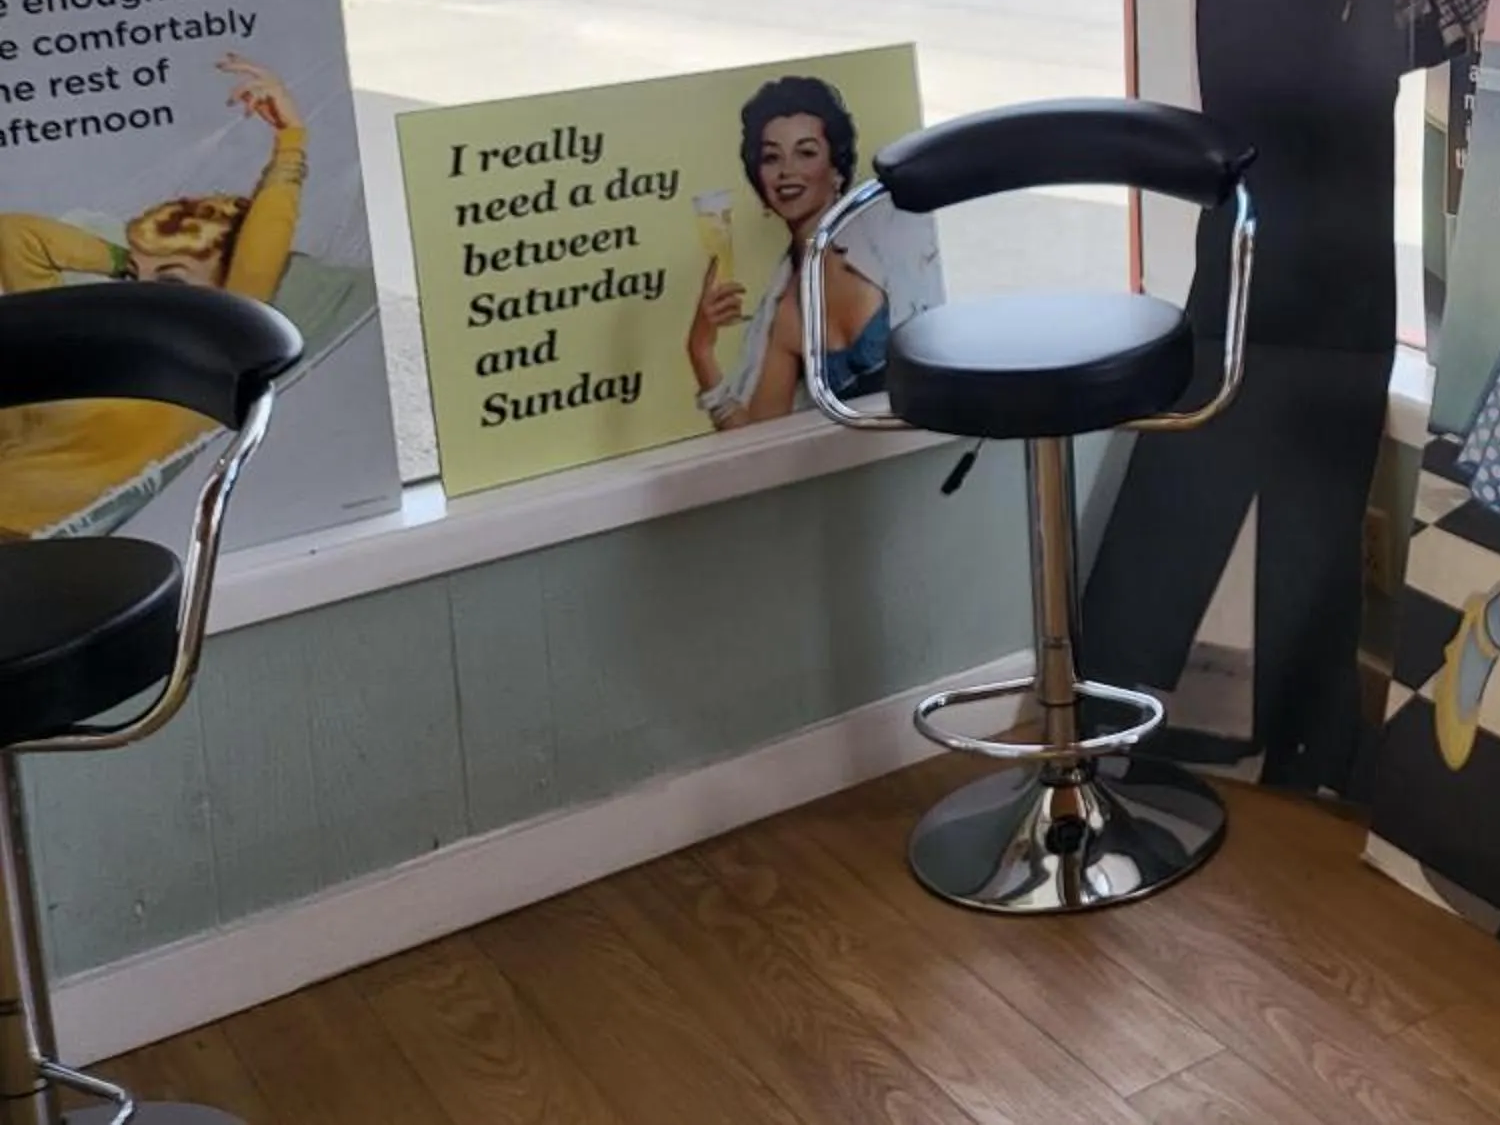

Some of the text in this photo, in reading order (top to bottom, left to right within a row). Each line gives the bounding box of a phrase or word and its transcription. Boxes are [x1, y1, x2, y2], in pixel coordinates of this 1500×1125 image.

[33, 8, 257, 56] comfortably
[49, 64, 119, 98] rest
[133, 57, 170, 87] of
[448, 125, 605, 178] I really
[456, 166, 680, 227] need a day
[463, 224, 640, 277] between
[467, 267, 667, 328] Saturday
[475, 328, 560, 377] and
[480, 370, 643, 428] Sunday
